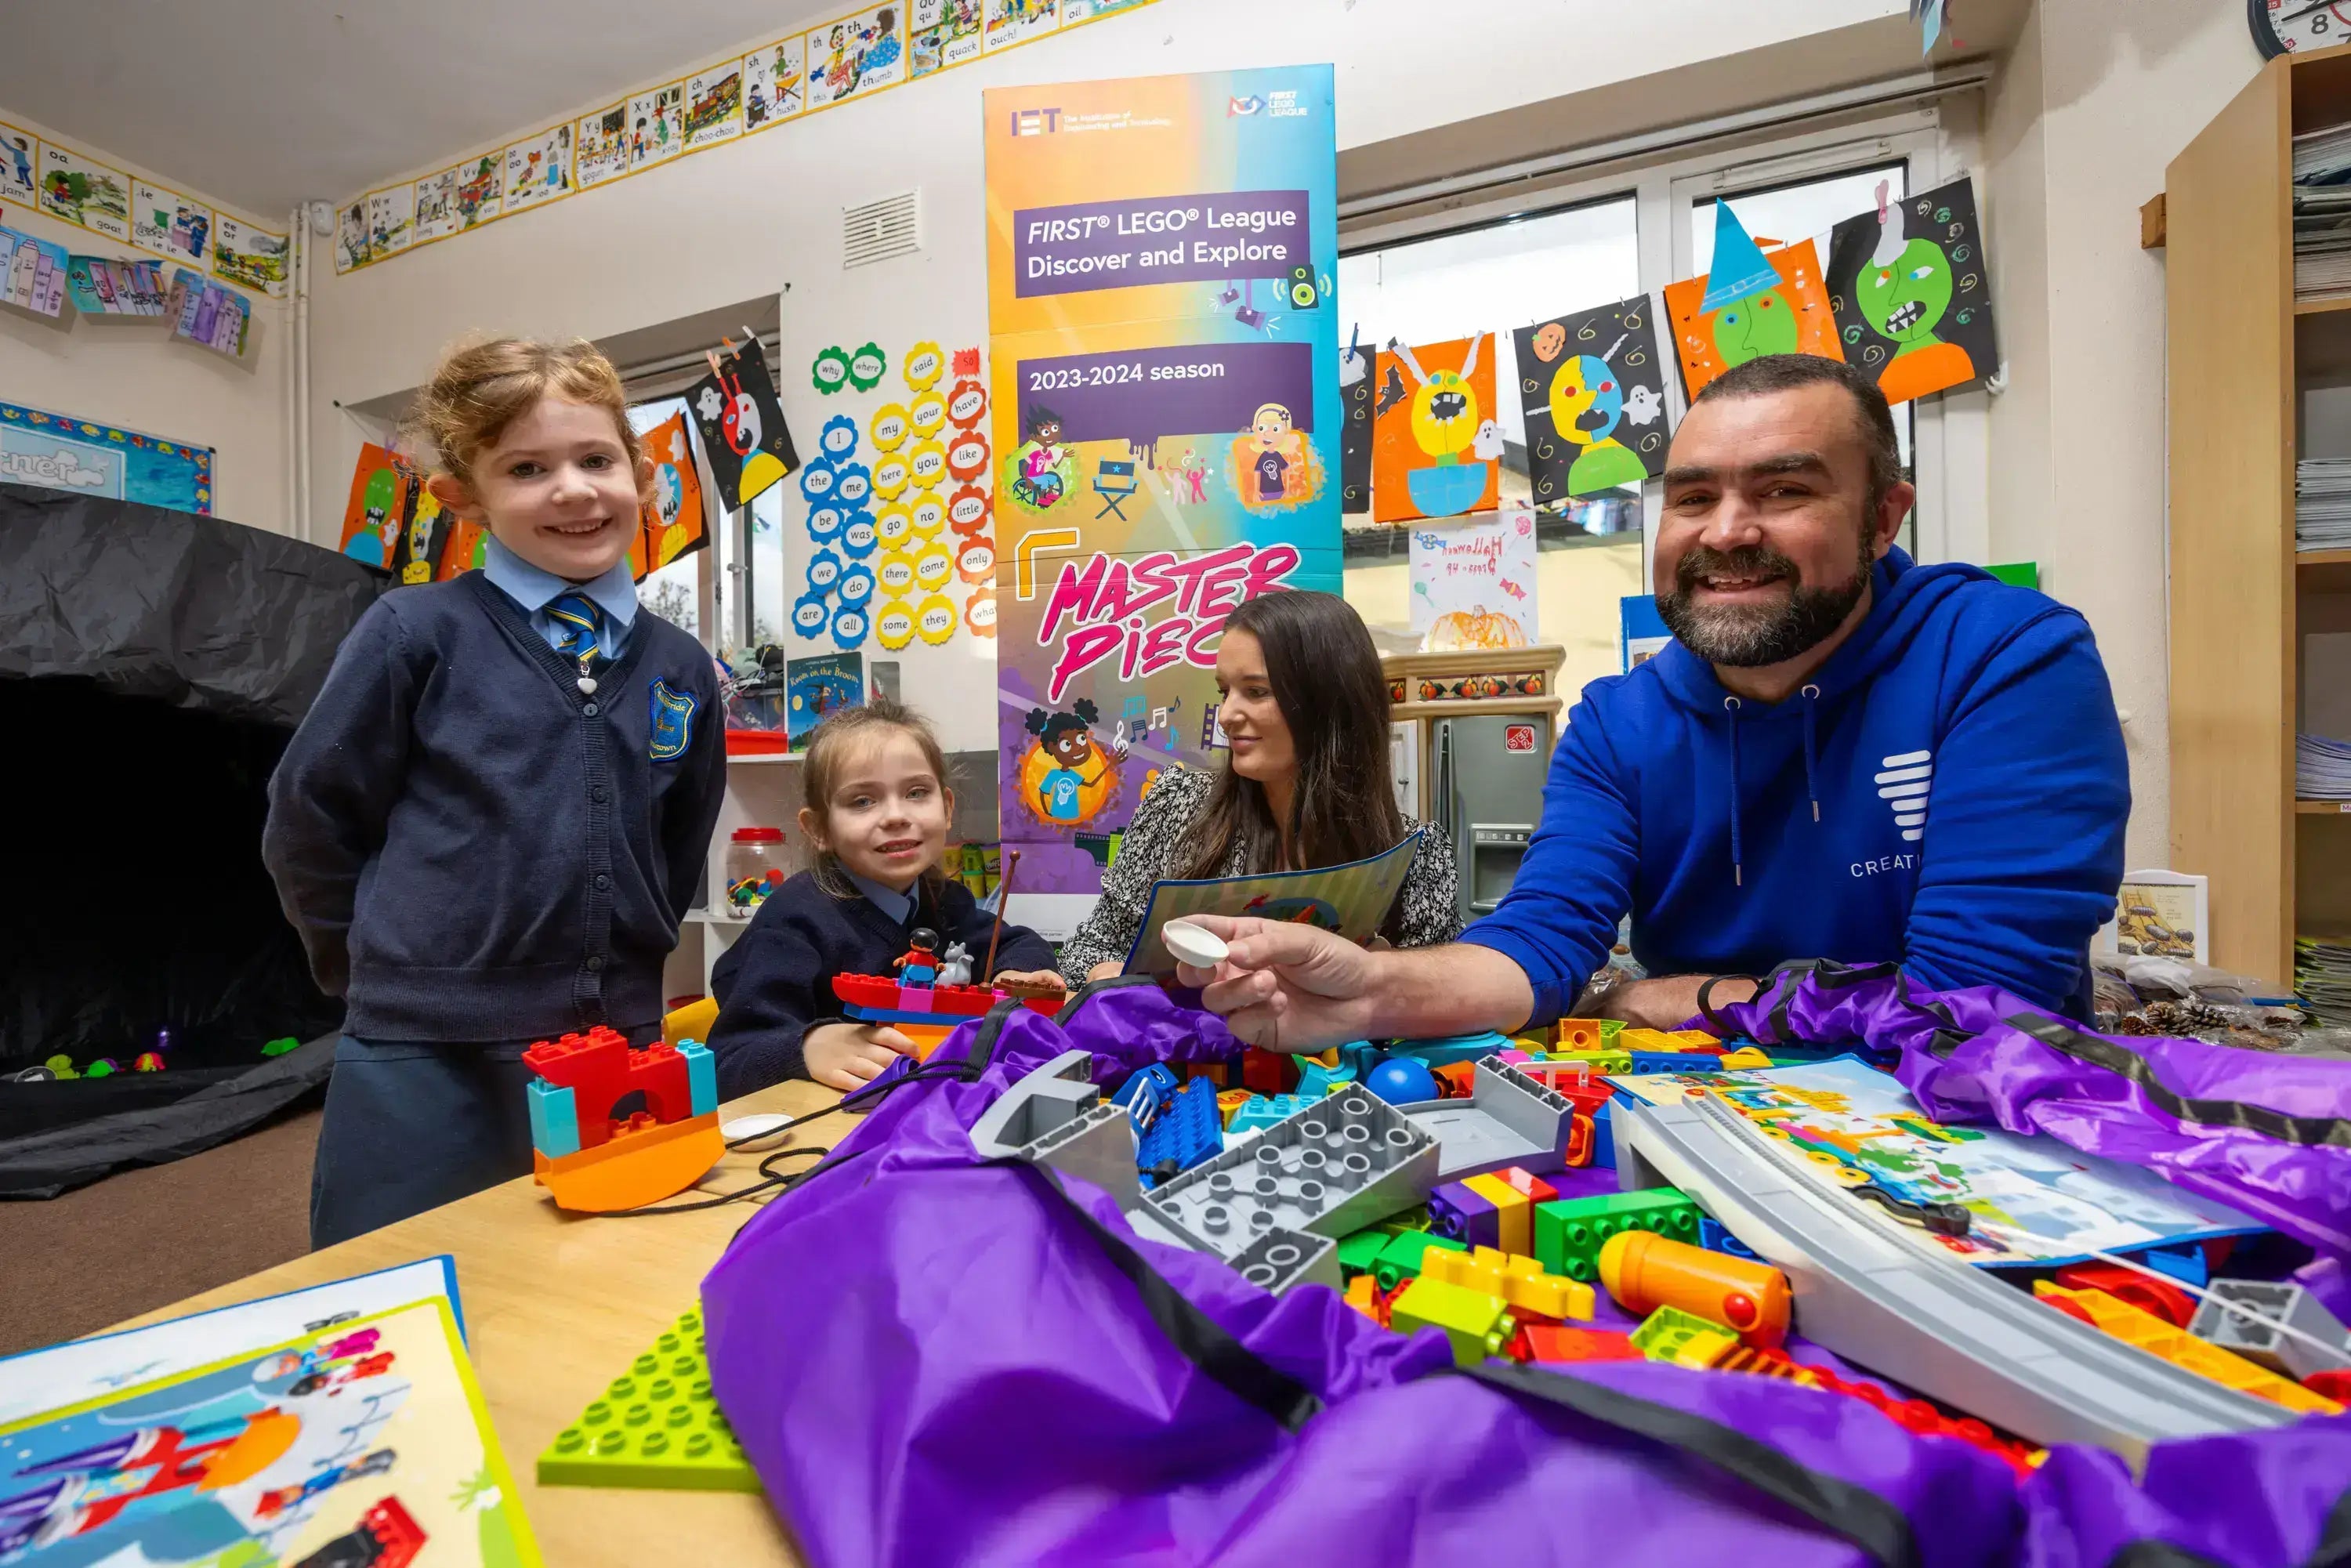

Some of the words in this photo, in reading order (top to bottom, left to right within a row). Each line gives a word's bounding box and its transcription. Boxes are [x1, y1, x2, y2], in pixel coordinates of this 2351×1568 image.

[918, 12, 933, 24] qu
[1067, 8, 1082, 20] oil
[847, 20, 862, 34] th
[2311, 14, 2329, 34] 8
[813, 37, 822, 49] th
[990, 29, 1017, 46] ouch!
[948, 42, 977, 60] quack
[748, 56, 760, 69] sh
[691, 78, 703, 91] ch
[862, 70, 893, 88] thumb
[634, 101, 643, 113] X
[776, 103, 797, 116] hush
[1270, 107, 1307, 117] LEAGUE
[585, 122, 592, 133] Y
[1010, 108, 1062, 137] IET
[694, 126, 735, 143] choo-choo
[49, 151, 69, 165] oa
[1, 183, 25, 199] jam
[141, 188, 154, 200] ie
[223, 221, 237, 232] ee
[1208, 207, 1297, 233] League
[96, 220, 122, 235] goat
[1028, 252, 1132, 278] Discover
[1139, 241, 1184, 267] and
[1194, 240, 1288, 268] Explore
[822, 366, 840, 378] why
[855, 363, 878, 373] where
[913, 357, 933, 373] said
[1030, 363, 1143, 392] 2023-2024
[1150, 363, 1225, 382] season
[955, 396, 978, 414] have
[916, 407, 940, 425] your
[836, 432, 842, 444] I
[881, 424, 899, 441] my
[958, 449, 977, 461] like
[916, 457, 939, 474] you
[810, 473, 828, 487] the
[880, 469, 901, 483] here
[846, 481, 862, 493] me
[920, 512, 935, 523] no
[956, 505, 980, 518] little
[819, 515, 831, 526] be
[887, 520, 900, 535] go
[849, 531, 871, 540] was
[965, 552, 988, 567] only
[817, 568, 831, 578] we
[885, 568, 908, 579] there
[920, 560, 945, 574] come
[849, 581, 863, 593] do
[1039, 543, 1298, 644] MASTER
[802, 610, 819, 621] are
[926, 613, 947, 627] they
[843, 617, 857, 631] all
[883, 621, 907, 630] some
[789, 672, 809, 687] Room
[820, 666, 832, 675] the
[834, 666, 859, 683] Broom
[1508, 727, 1530, 748] STEP
[1520, 739, 1532, 749] 2
